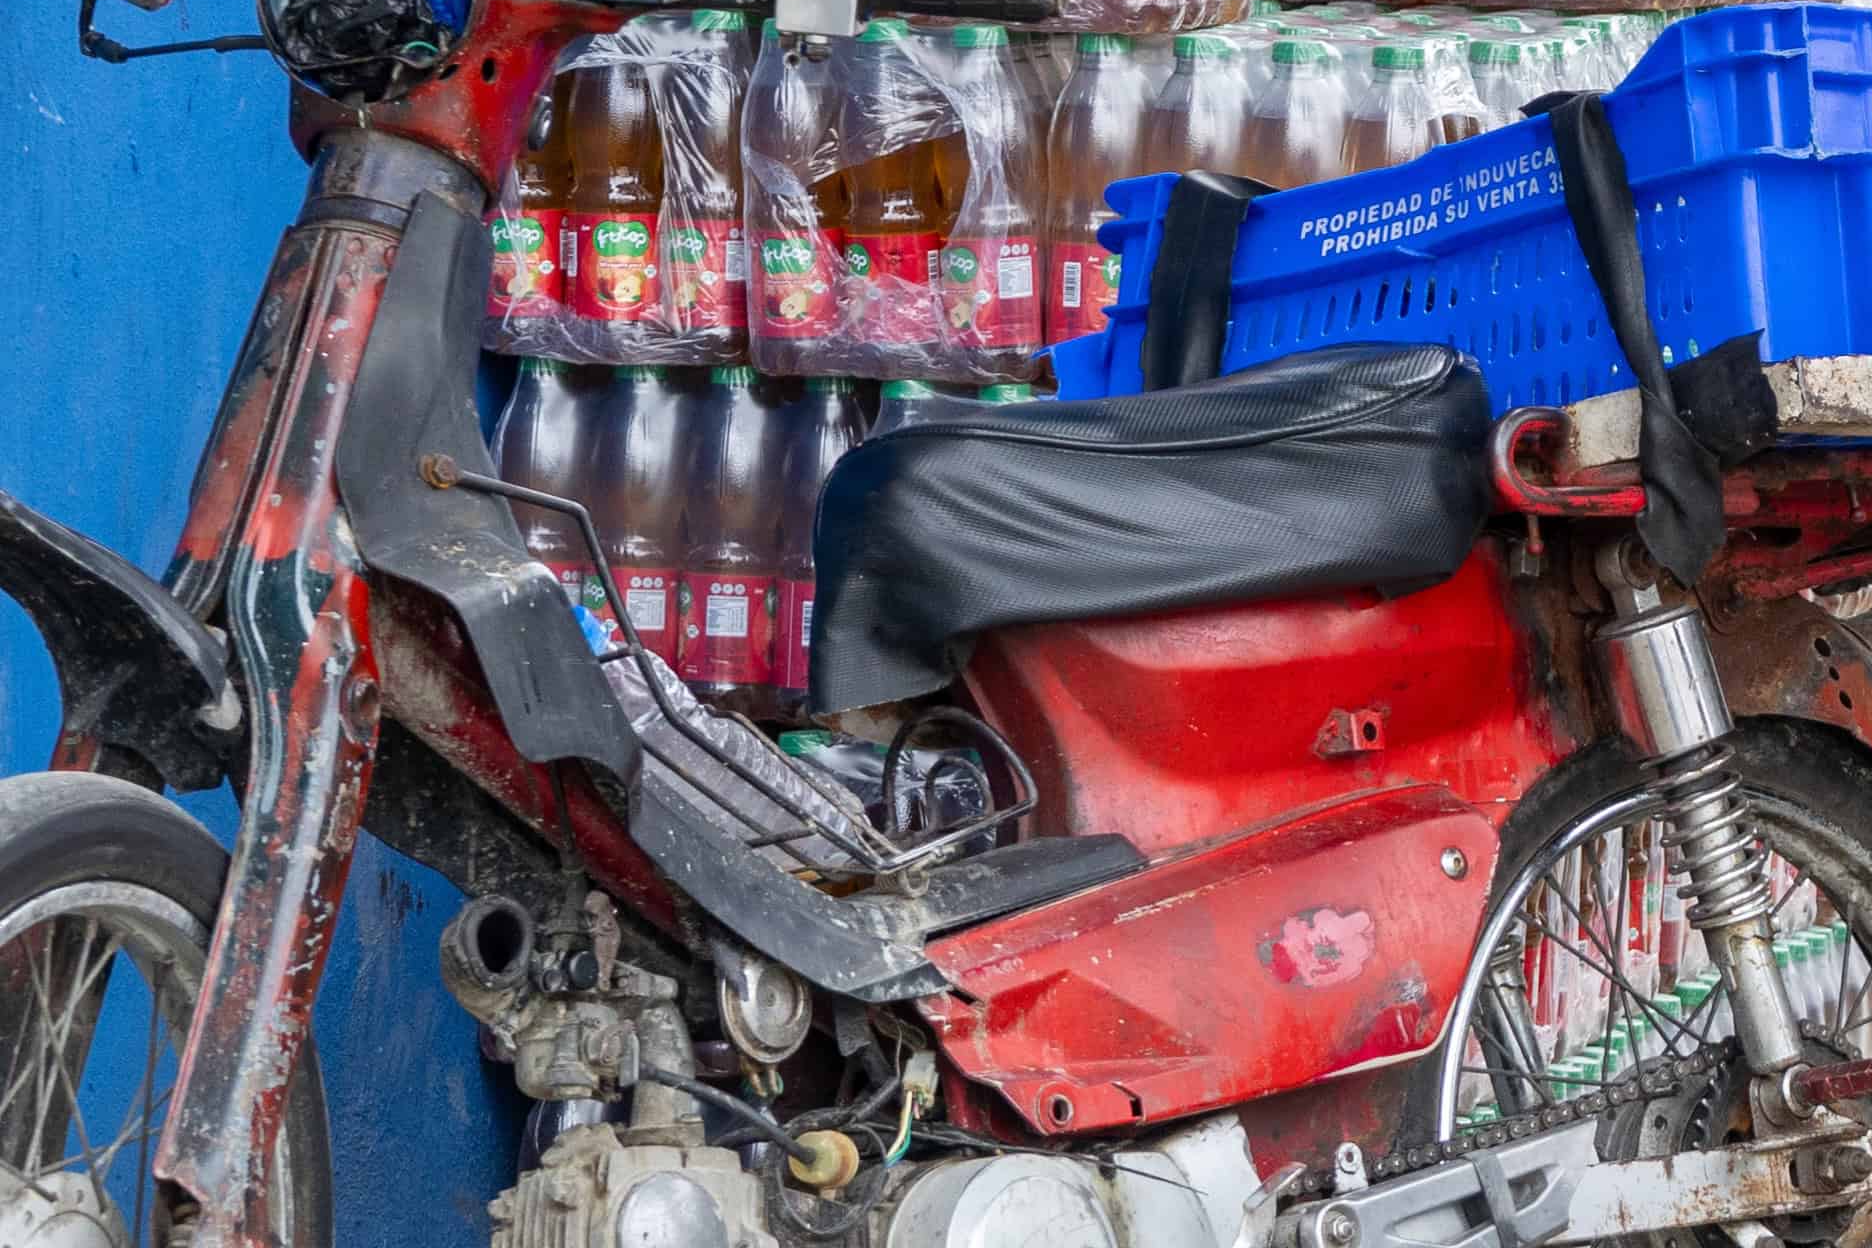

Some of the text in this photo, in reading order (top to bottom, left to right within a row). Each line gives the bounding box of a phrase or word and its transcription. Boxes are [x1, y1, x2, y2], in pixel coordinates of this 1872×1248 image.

[1300, 146, 1556, 240] PROPIEDAD DE INDUVECA
[1320, 210, 1439, 257] PROHIBIDA
[1445, 200, 1469, 223] SU
[1477, 176, 1540, 212] VENTA
